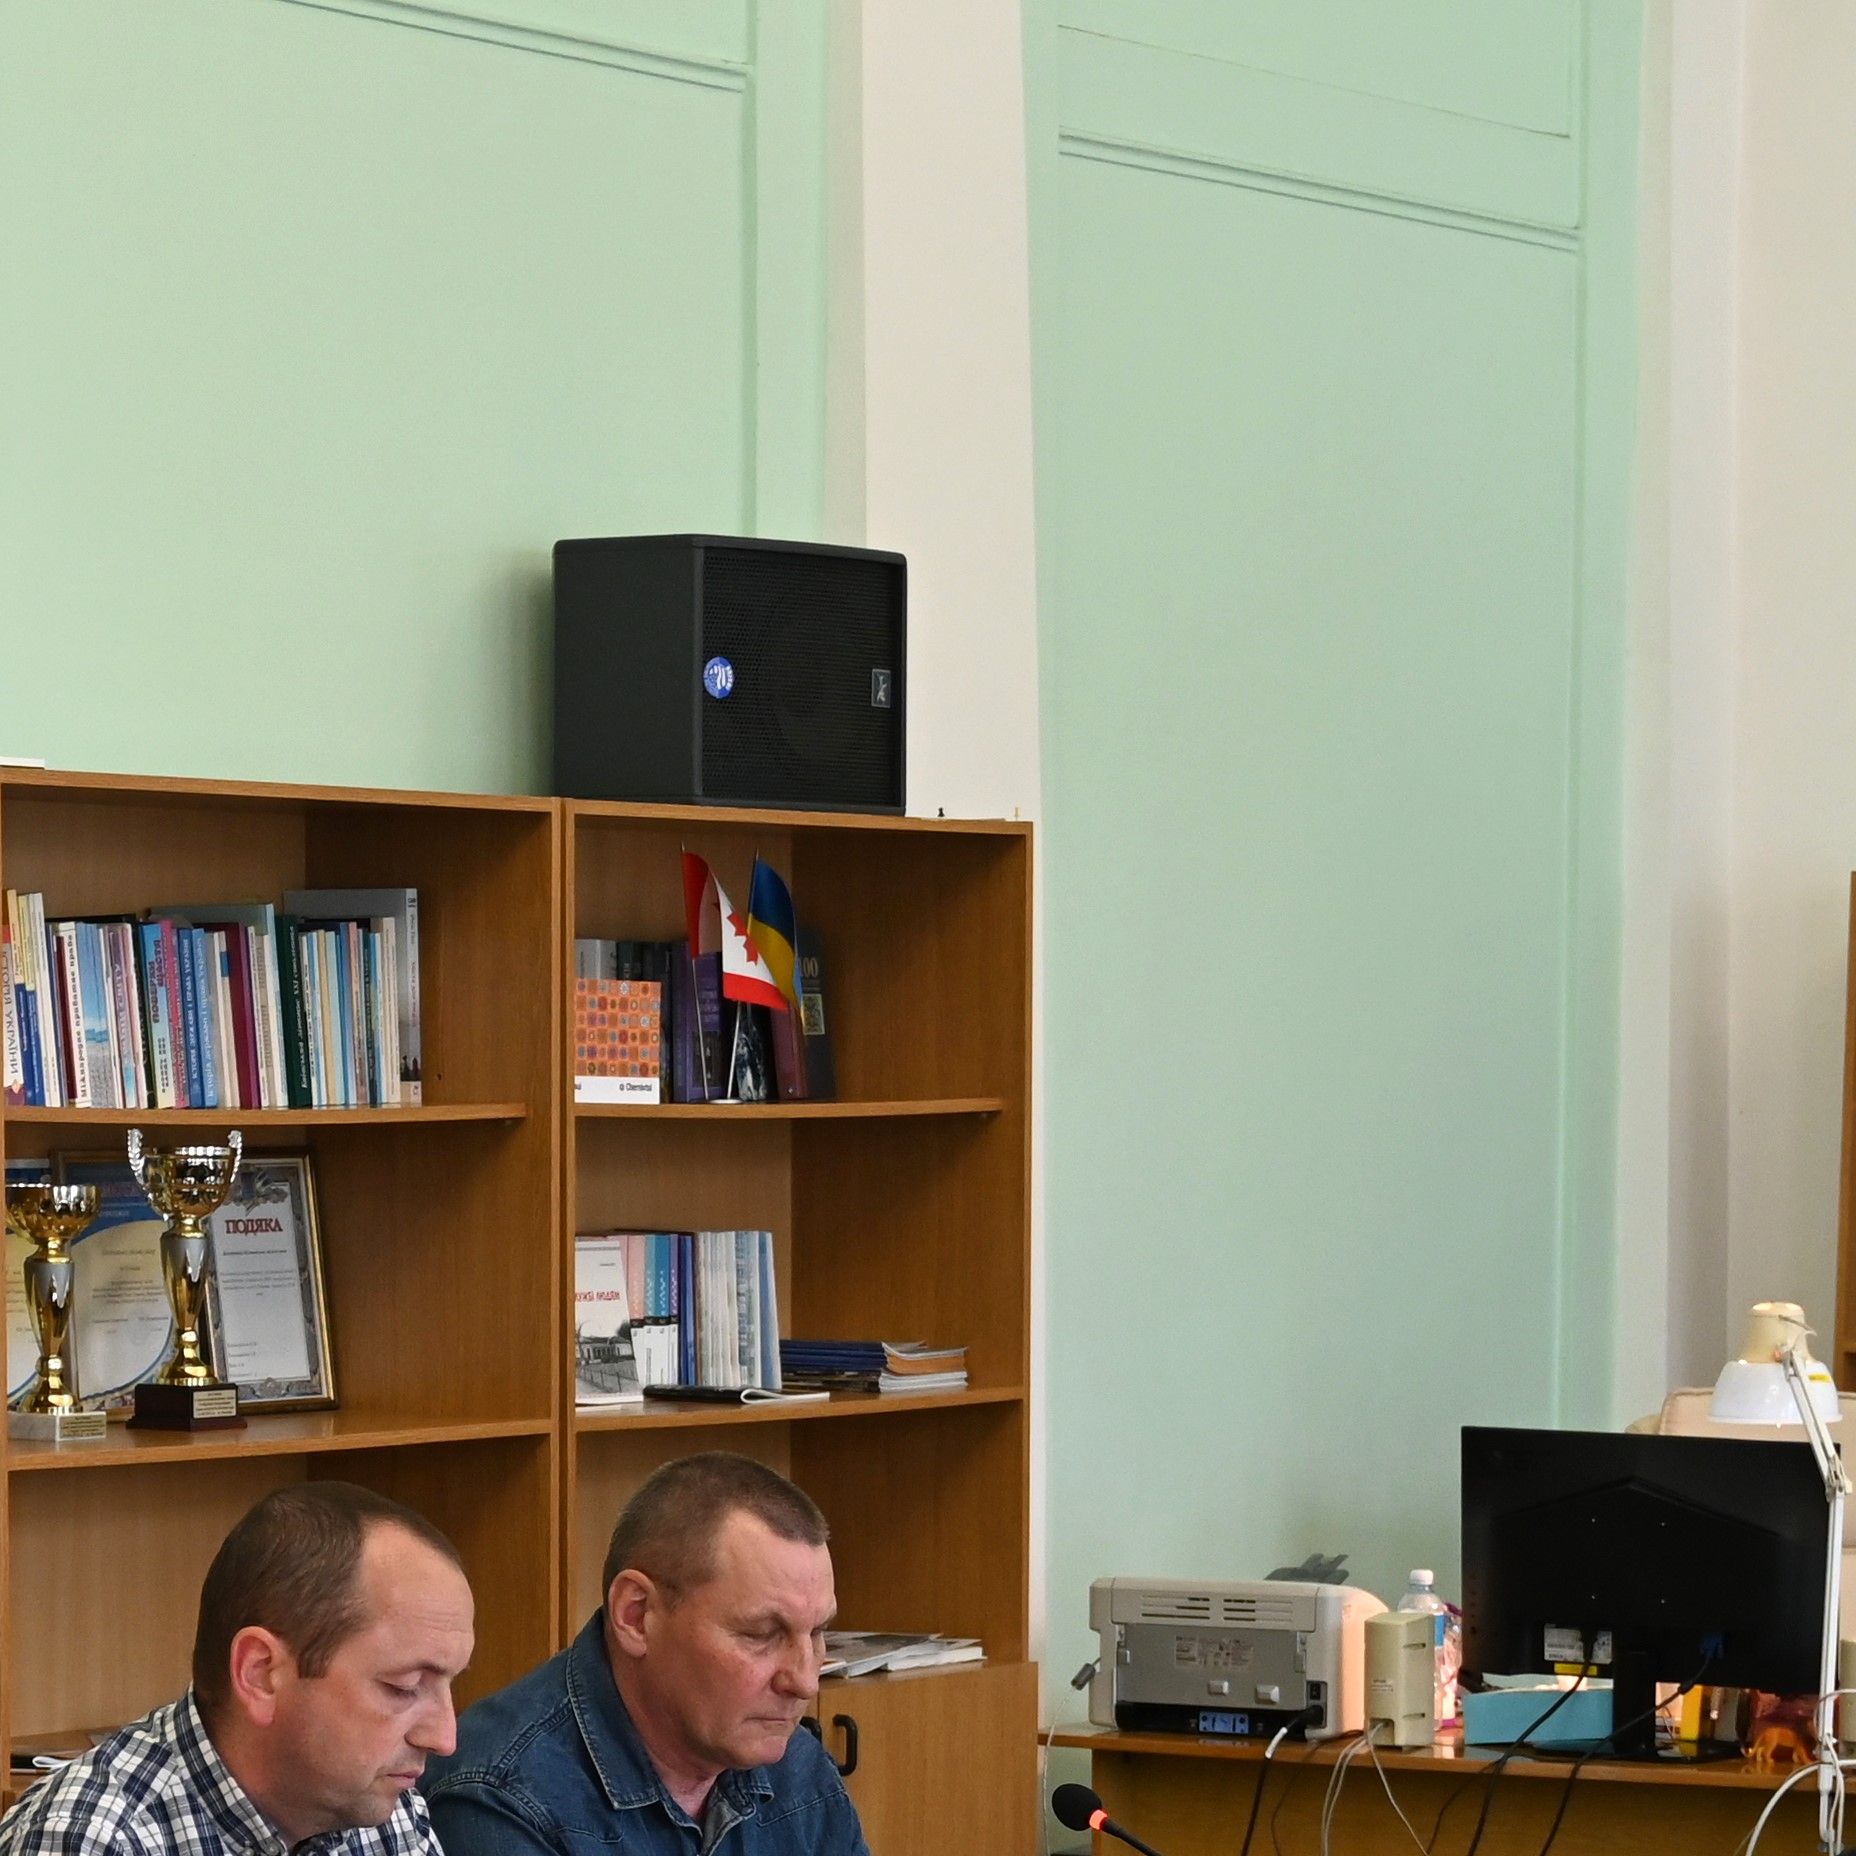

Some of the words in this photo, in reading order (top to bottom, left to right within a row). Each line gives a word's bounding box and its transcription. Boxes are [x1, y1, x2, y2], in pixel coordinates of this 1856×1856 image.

[799, 957, 819, 977] 00
[5, 1010, 19, 1073] УКРАЇНИ
[225, 1217, 283, 1236] ПОДЯКА
